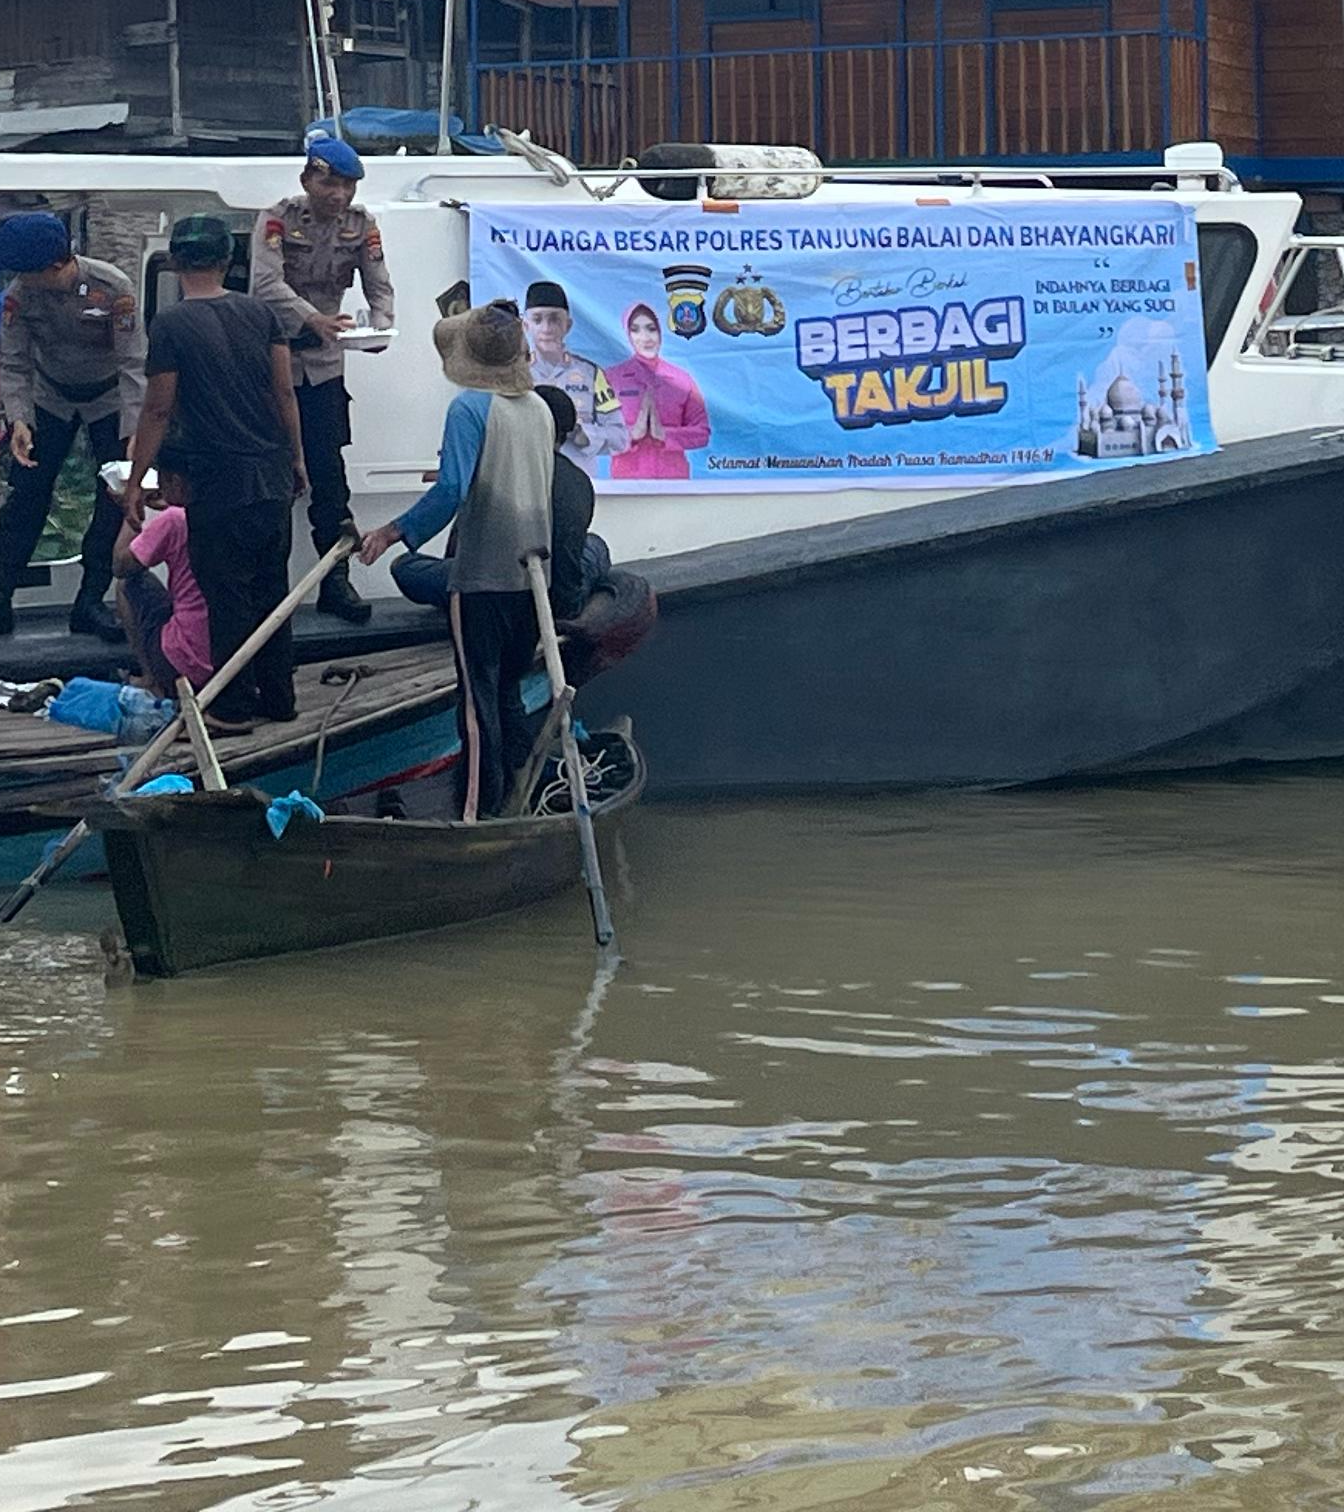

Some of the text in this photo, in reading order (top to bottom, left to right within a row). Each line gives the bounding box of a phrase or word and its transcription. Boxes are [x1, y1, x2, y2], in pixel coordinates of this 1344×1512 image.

[614, 229, 690, 252] BESAR
[696, 229, 783, 252] POLRES
[786, 226, 892, 251] TANJUNG
[896, 226, 961, 249] BALAI
[967, 225, 1014, 248] DAN
[1020, 224, 1175, 248] BHAYANGKARI
[1035, 278, 1171, 295] INDAHNYA BERBAGI
[1033, 297, 1176, 314] DI BULAN YANG SUCI
[797, 296, 1026, 369] BERBAGI
[822, 358, 1008, 422] TAKJIL
[708, 455, 761, 469] Selamat
[896, 451, 935, 466] Puasa
[938, 449, 1007, 465] Ramadhan
